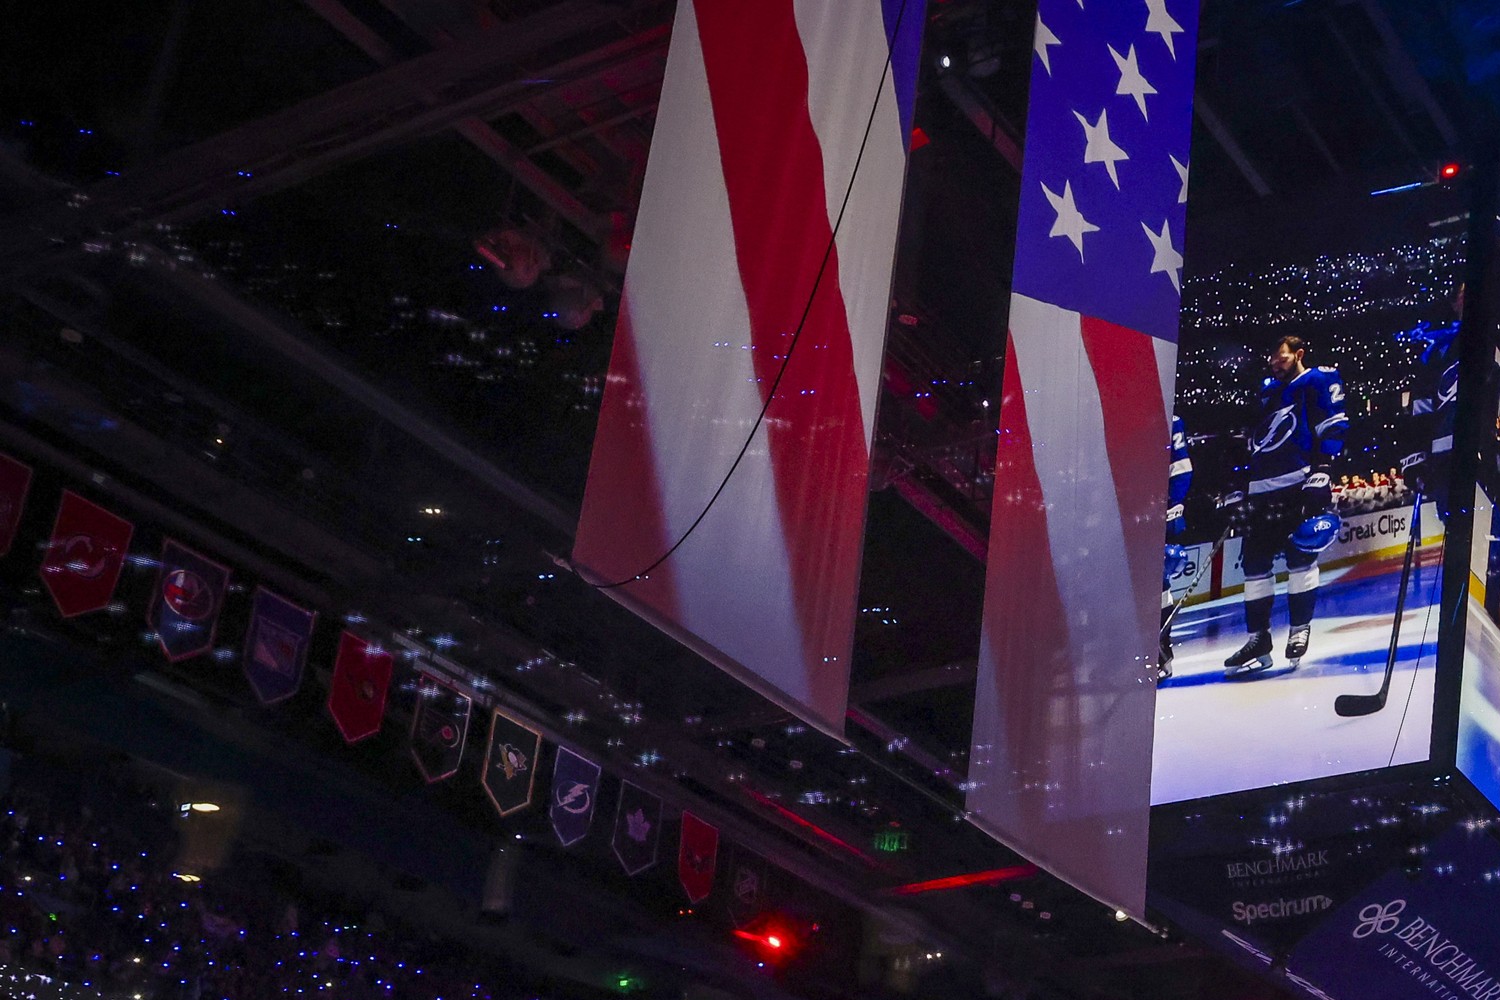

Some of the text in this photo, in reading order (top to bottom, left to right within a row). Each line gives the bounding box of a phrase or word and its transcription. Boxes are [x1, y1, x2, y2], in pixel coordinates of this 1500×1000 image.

[1338, 520, 1376, 543] Great
[1378, 515, 1406, 536] Clips
[1226, 849, 1330, 879] BENCHMARK
[1232, 894, 1331, 925] Spectrum
